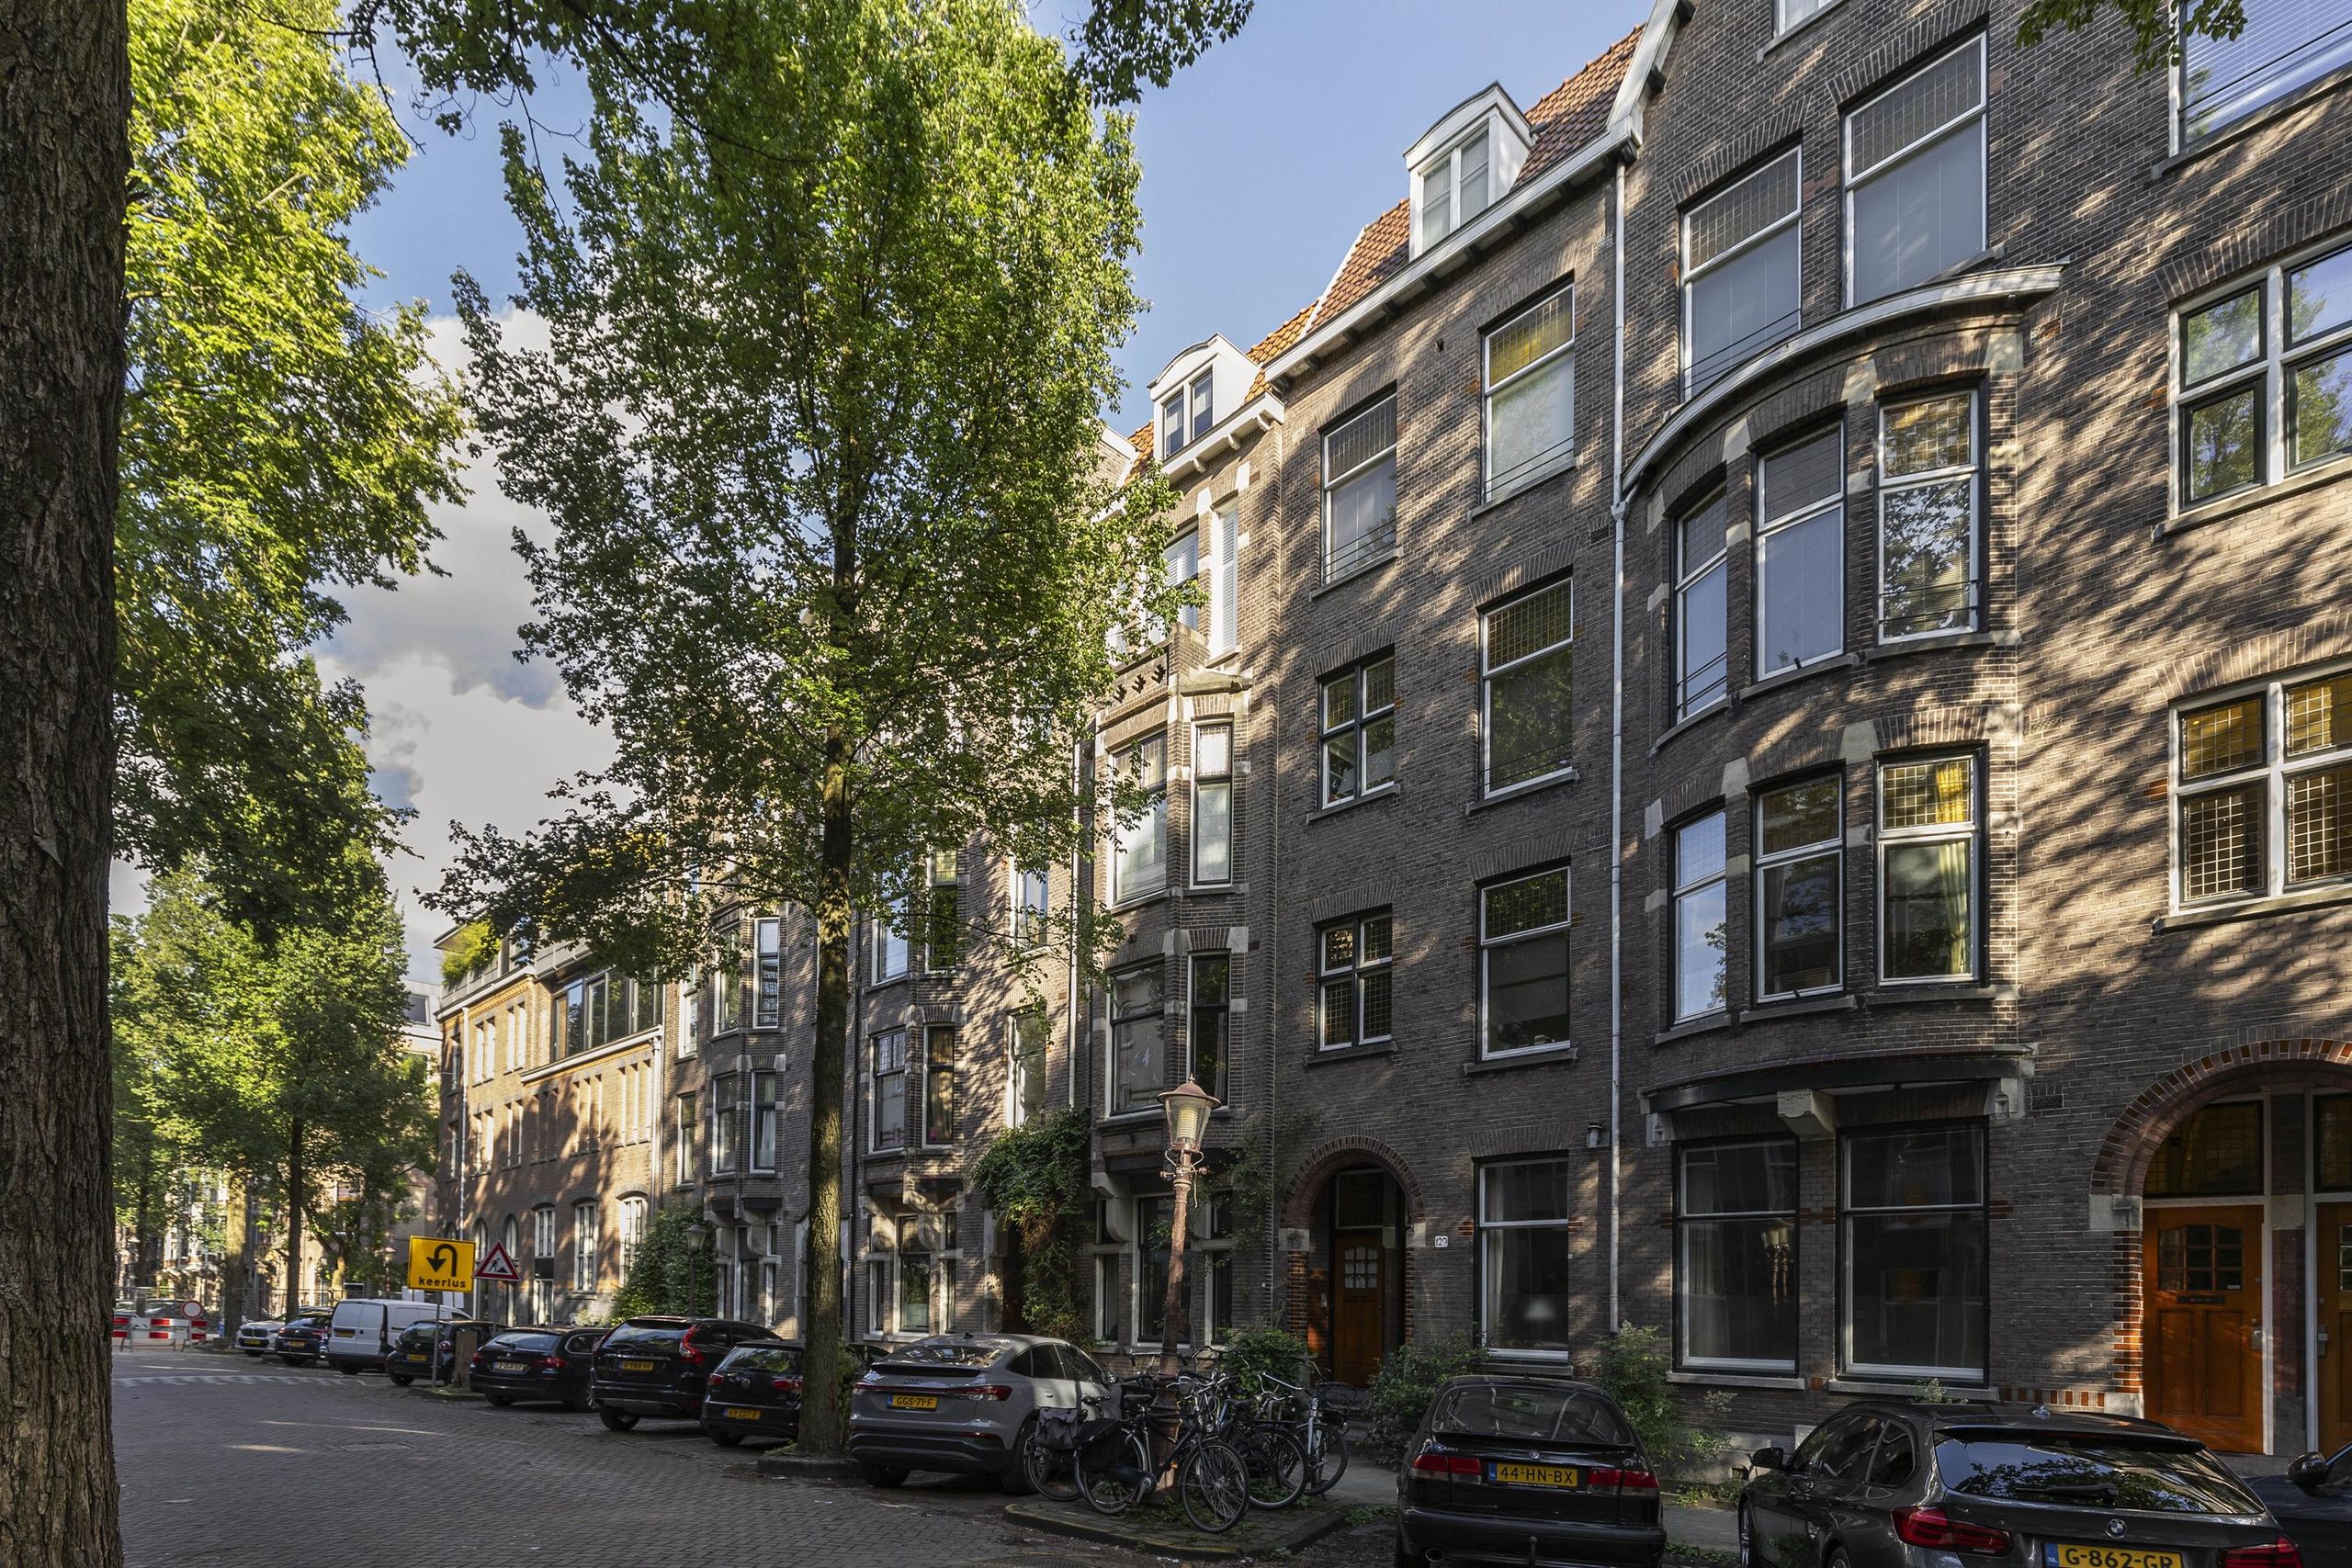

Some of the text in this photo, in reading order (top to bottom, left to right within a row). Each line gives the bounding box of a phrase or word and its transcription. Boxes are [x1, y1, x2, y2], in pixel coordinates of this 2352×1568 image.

[418, 1275, 467, 1288] keerlus
[897, 1396, 933, 1407] GGS-71-F
[1499, 1466, 1574, 1483] 44-HN-BX
[2065, 1548, 2174, 1568] G-862-GR
